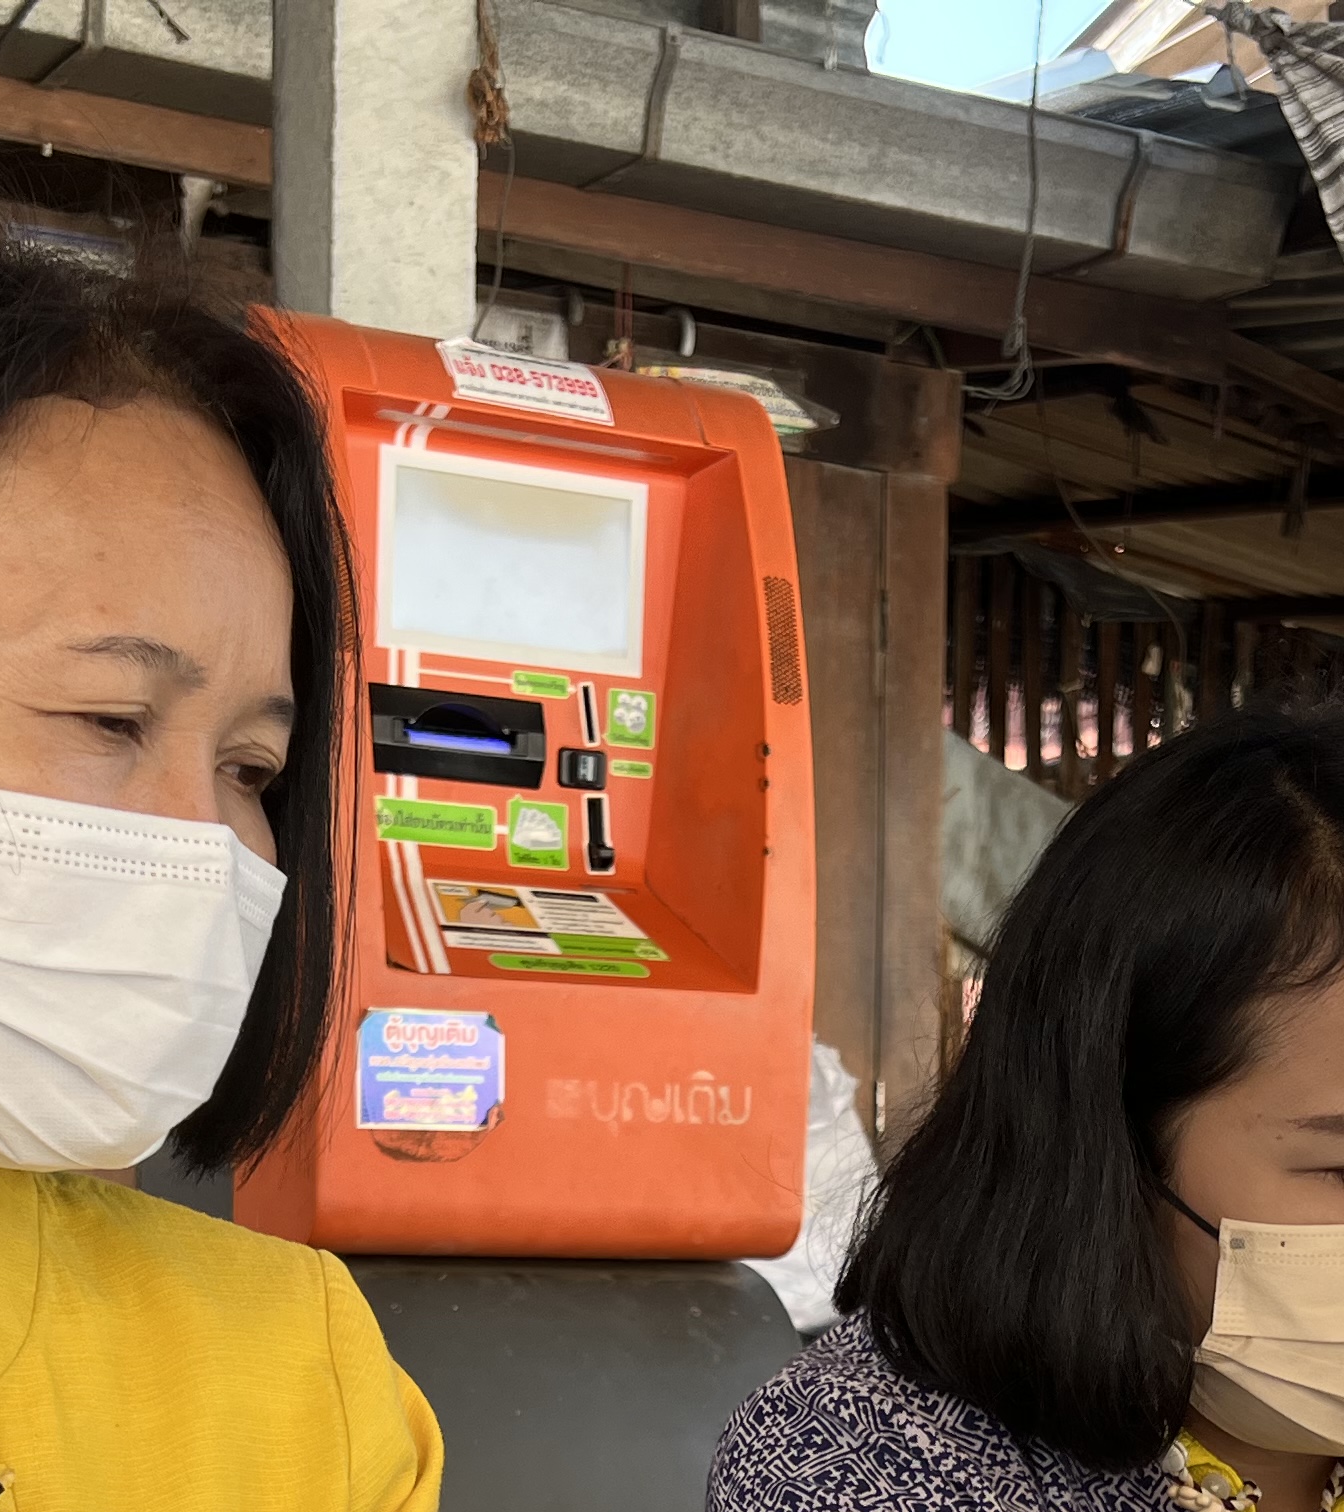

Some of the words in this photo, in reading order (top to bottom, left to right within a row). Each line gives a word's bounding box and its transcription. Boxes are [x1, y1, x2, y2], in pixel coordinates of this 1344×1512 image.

[384, 1015, 478, 1052] ตู้บุญเติม
[588, 1070, 753, 1138] บุญเติม
